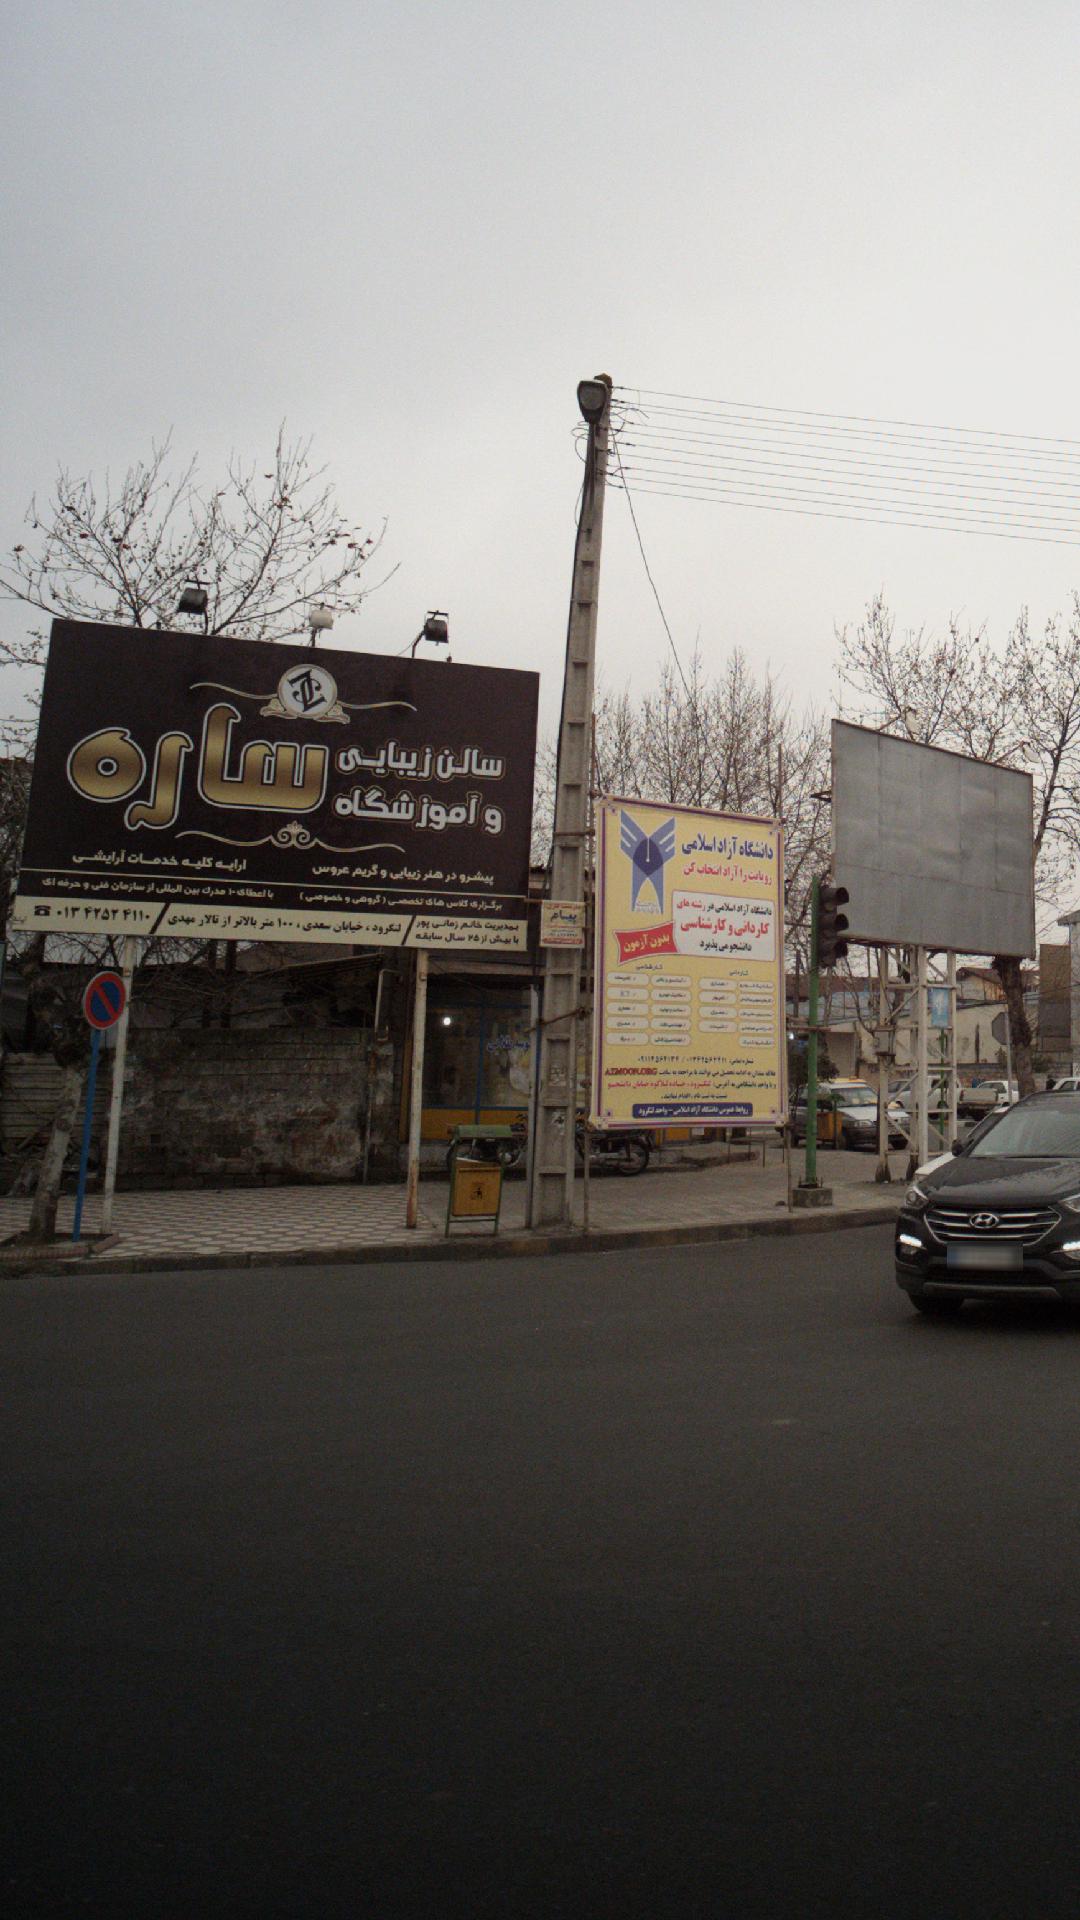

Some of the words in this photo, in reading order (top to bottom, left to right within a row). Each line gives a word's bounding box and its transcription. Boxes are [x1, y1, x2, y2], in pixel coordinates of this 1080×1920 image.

[337, 742, 434, 777] زیبایی
[437, 748, 503, 779] سالن
[67, 703, 330, 830] ساره
[335, 789, 478, 831] آموزشگاه
[484, 807, 502, 834] و
[681, 832, 716, 855] اسلامی
[717, 836, 738, 860] آزاد
[739, 840, 774, 860] دانشگاه
[72, 849, 125, 864] آرایشی
[127, 853, 178, 866] خدمات
[181, 856, 213, 869] کلیه
[215, 859, 247, 872] ارایه
[312, 865, 350, 876] عروس
[351, 864, 379, 878] گریم
[381, 869, 387, 878] و
[389, 866, 421, 880] زیبایی
[423, 871, 443, 882] هنر
[444, 872, 456, 882] در
[459, 871, 494, 885] پیشرو
[42, 877, 57, 887] ای
[57, 878, 82, 890] حرفه
[90, 880, 109, 890] فنی
[110, 881, 145, 892] سازمان
[145, 883, 155, 894] از
[155, 883, 183, 894] المللی
[183, 885, 200, 895] بین
[201, 886, 226, 897] مدرک
[266, 889, 274, 900] با
[387, 894, 424, 906] تخصصی
[425, 898, 445, 907] های
[446, 898, 468, 909] کلاس
[469, 900, 503, 911] برگزاری
[691, 900, 706, 911] رشته
[715, 902, 736, 913] اسلامی
[737, 903, 749, 916] آزاد
[750, 904, 772, 915] دانشگاه
[166, 913, 196, 925] مهدی
[199, 914, 220, 926] تالار
[220, 915, 231, 927] از
[233, 915, 257, 928] بالاتر
[259, 917, 274, 929] متر
[416, 920, 430, 929] پور
[431, 920, 459, 930] زمانی
[460, 920, 482, 930] خانم
[680, 916, 727, 934] کارشناسی
[303, 921, 331, 933] سعدی
[333, 921, 363, 933] خیابان
[728, 923, 734, 936] و
[734, 920, 770, 938] کاردانی
[415, 932, 443, 941] سابقه
[445, 933, 465, 942] سال
[481, 934, 488, 944] از
[489, 935, 512, 944] بیش
[650, 933, 671, 948] بدون
[623, 933, 649, 953] آزمون
[729, 942, 752, 953] دانشجو
